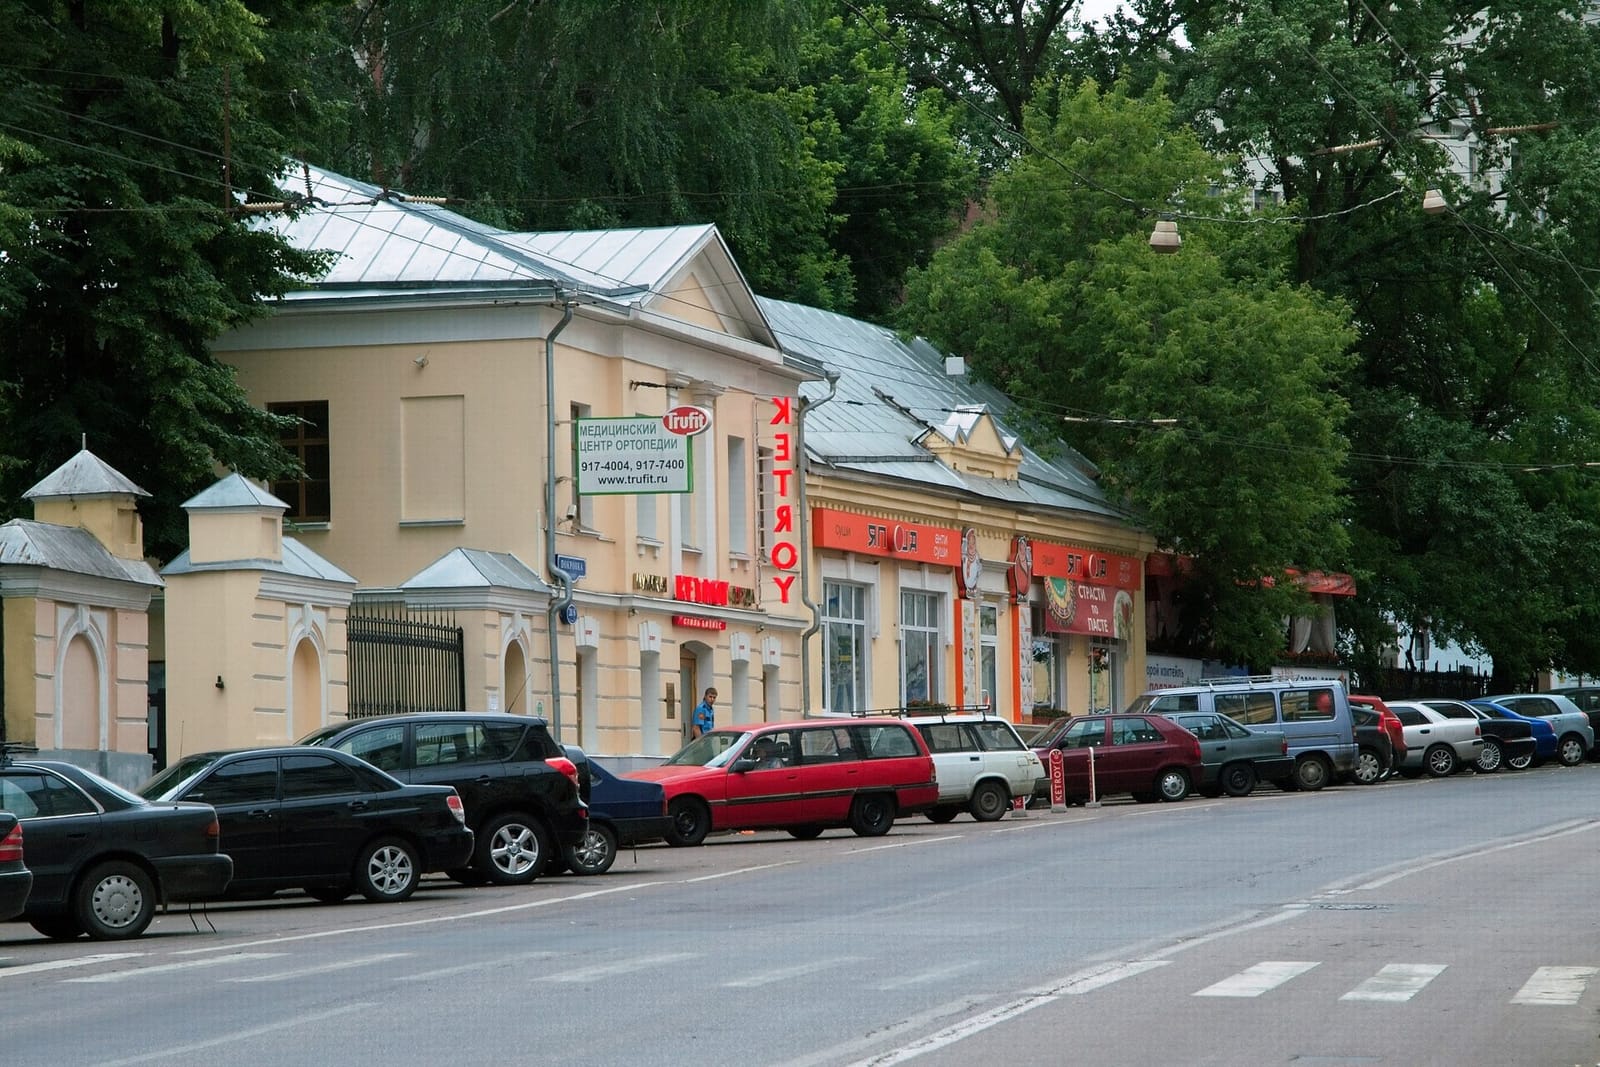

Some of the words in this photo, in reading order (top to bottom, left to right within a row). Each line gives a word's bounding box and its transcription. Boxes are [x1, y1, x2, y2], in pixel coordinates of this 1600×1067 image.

[667, 411, 705, 430] Trufit
[579, 422, 657, 438] МЕДИЦИНСКИЙ
[579, 440, 613, 453] ЦЕНТР
[615, 438, 678, 452] ОРТОПЕДИИ
[581, 461, 633, 472] 917-4004,
[635, 459, 685, 471] 917-7400
[597, 473, 668, 485] www.trufit.ru
[1078, 584, 1107, 602] СТРАСТИ
[1091, 604, 1099, 615] ПО
[1087, 617, 1109, 633] ПАСТЕ
[1054, 766, 1063, 801] KETROY
